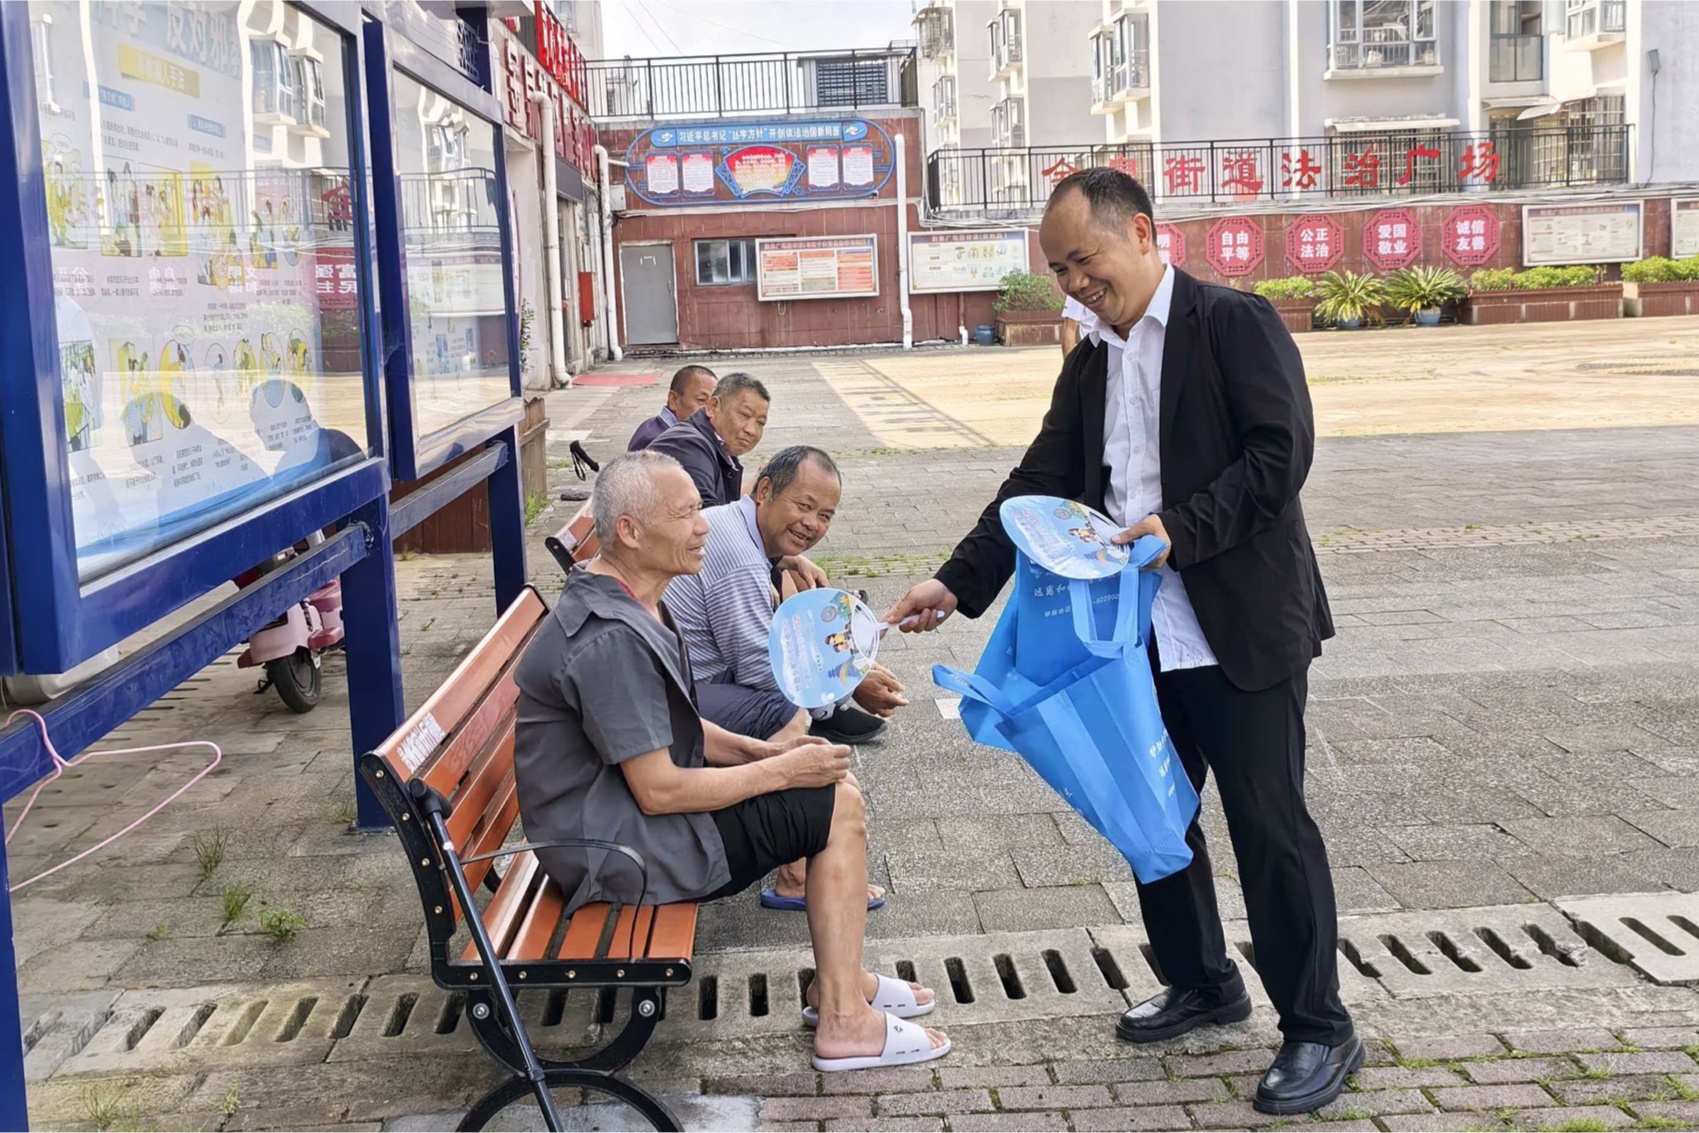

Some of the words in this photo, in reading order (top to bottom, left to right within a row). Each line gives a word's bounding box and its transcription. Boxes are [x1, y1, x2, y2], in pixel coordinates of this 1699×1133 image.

[1378, 223, 1407, 239] 爱国
[1456, 219, 1485, 235] 诚信
[1222, 230, 1249, 246] 自由
[1300, 228, 1329, 242] 公正
[1300, 243, 1329, 258] 法治
[1378, 240, 1407, 255] 敬业
[1456, 236, 1485, 251] 友善
[1221, 246, 1250, 262] 平等
[1034, 583, 1071, 598] 远离和
